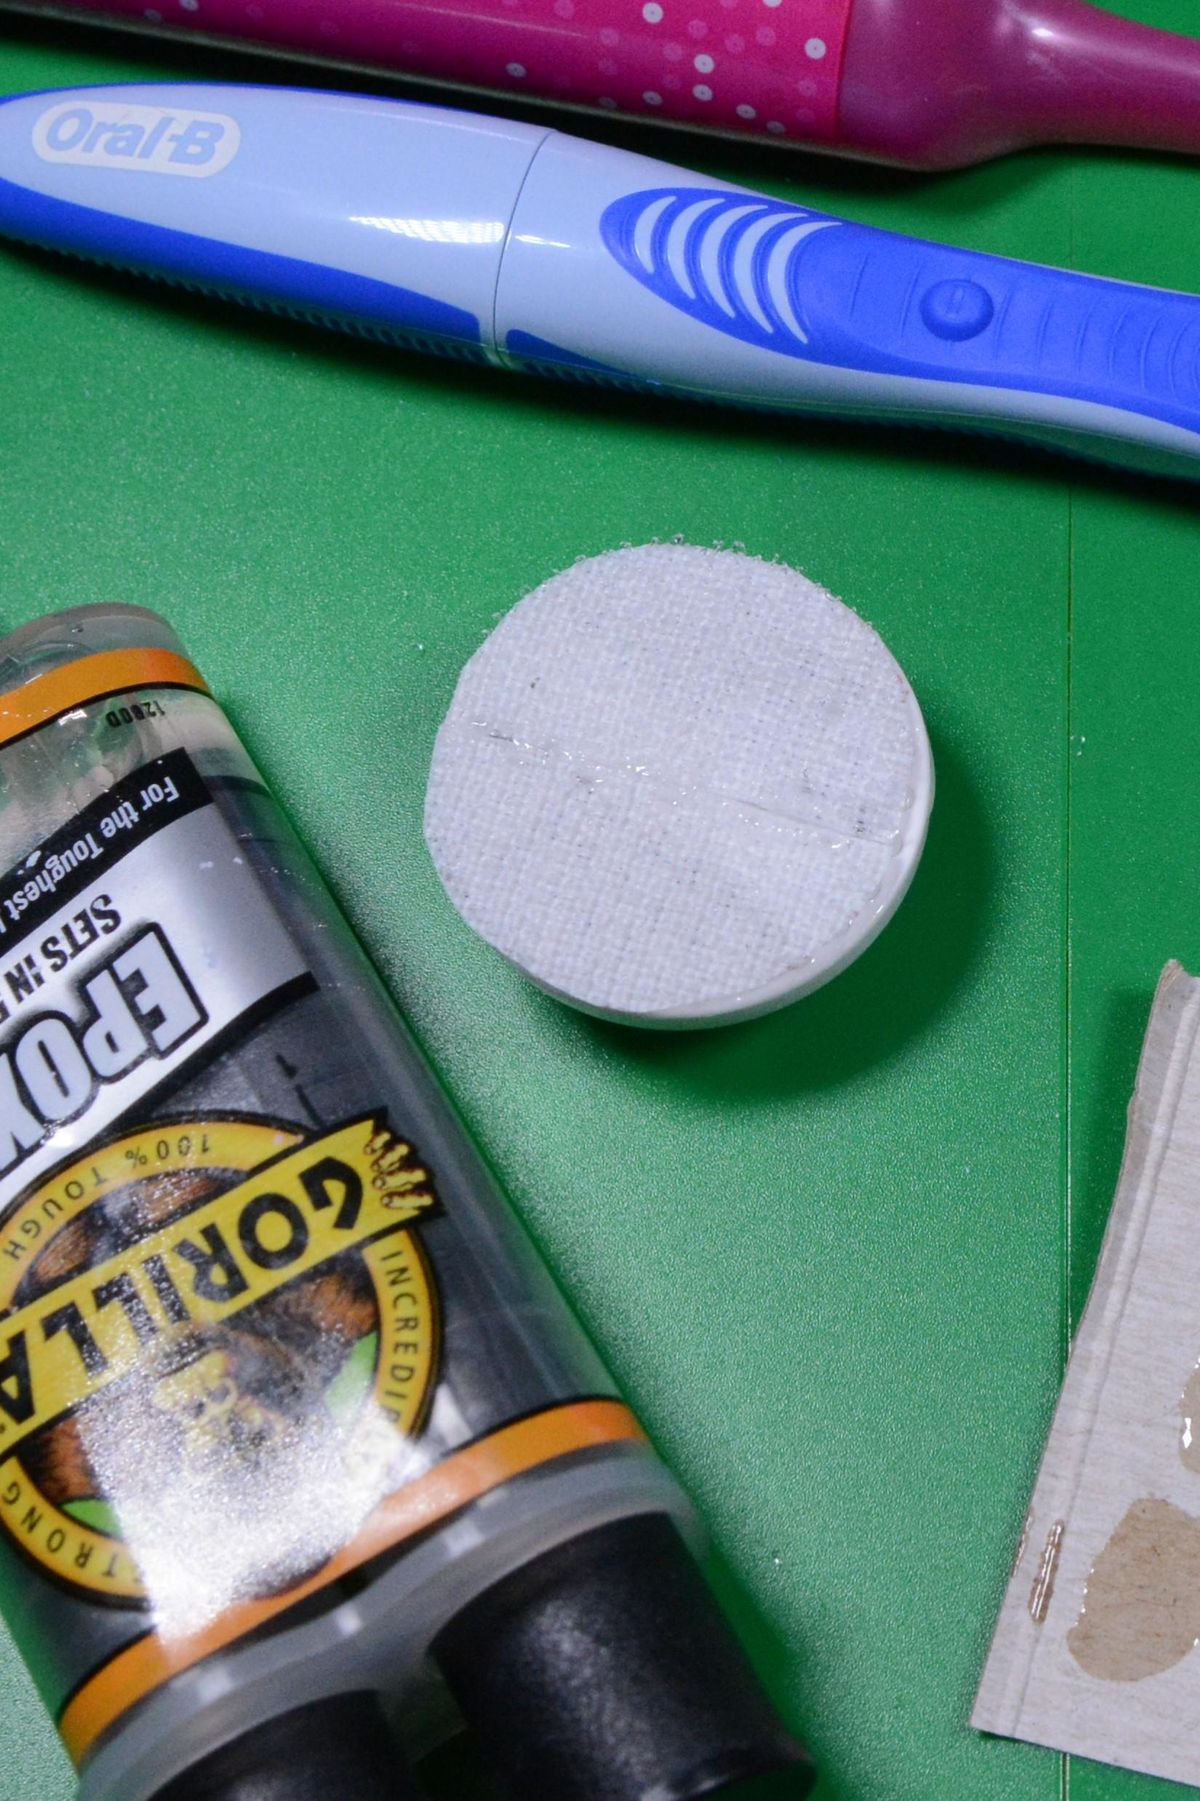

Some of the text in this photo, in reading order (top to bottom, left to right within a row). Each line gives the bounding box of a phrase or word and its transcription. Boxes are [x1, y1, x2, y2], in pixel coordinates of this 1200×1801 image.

[46, 108, 225, 166] Oral-B
[3, 776, 180, 920] For the Toughest
[4, 893, 121, 1004] SETS IN
[2, 1134, 210, 1260] 100% TOUGH
[0, 1156, 364, 1425] GORILLA
